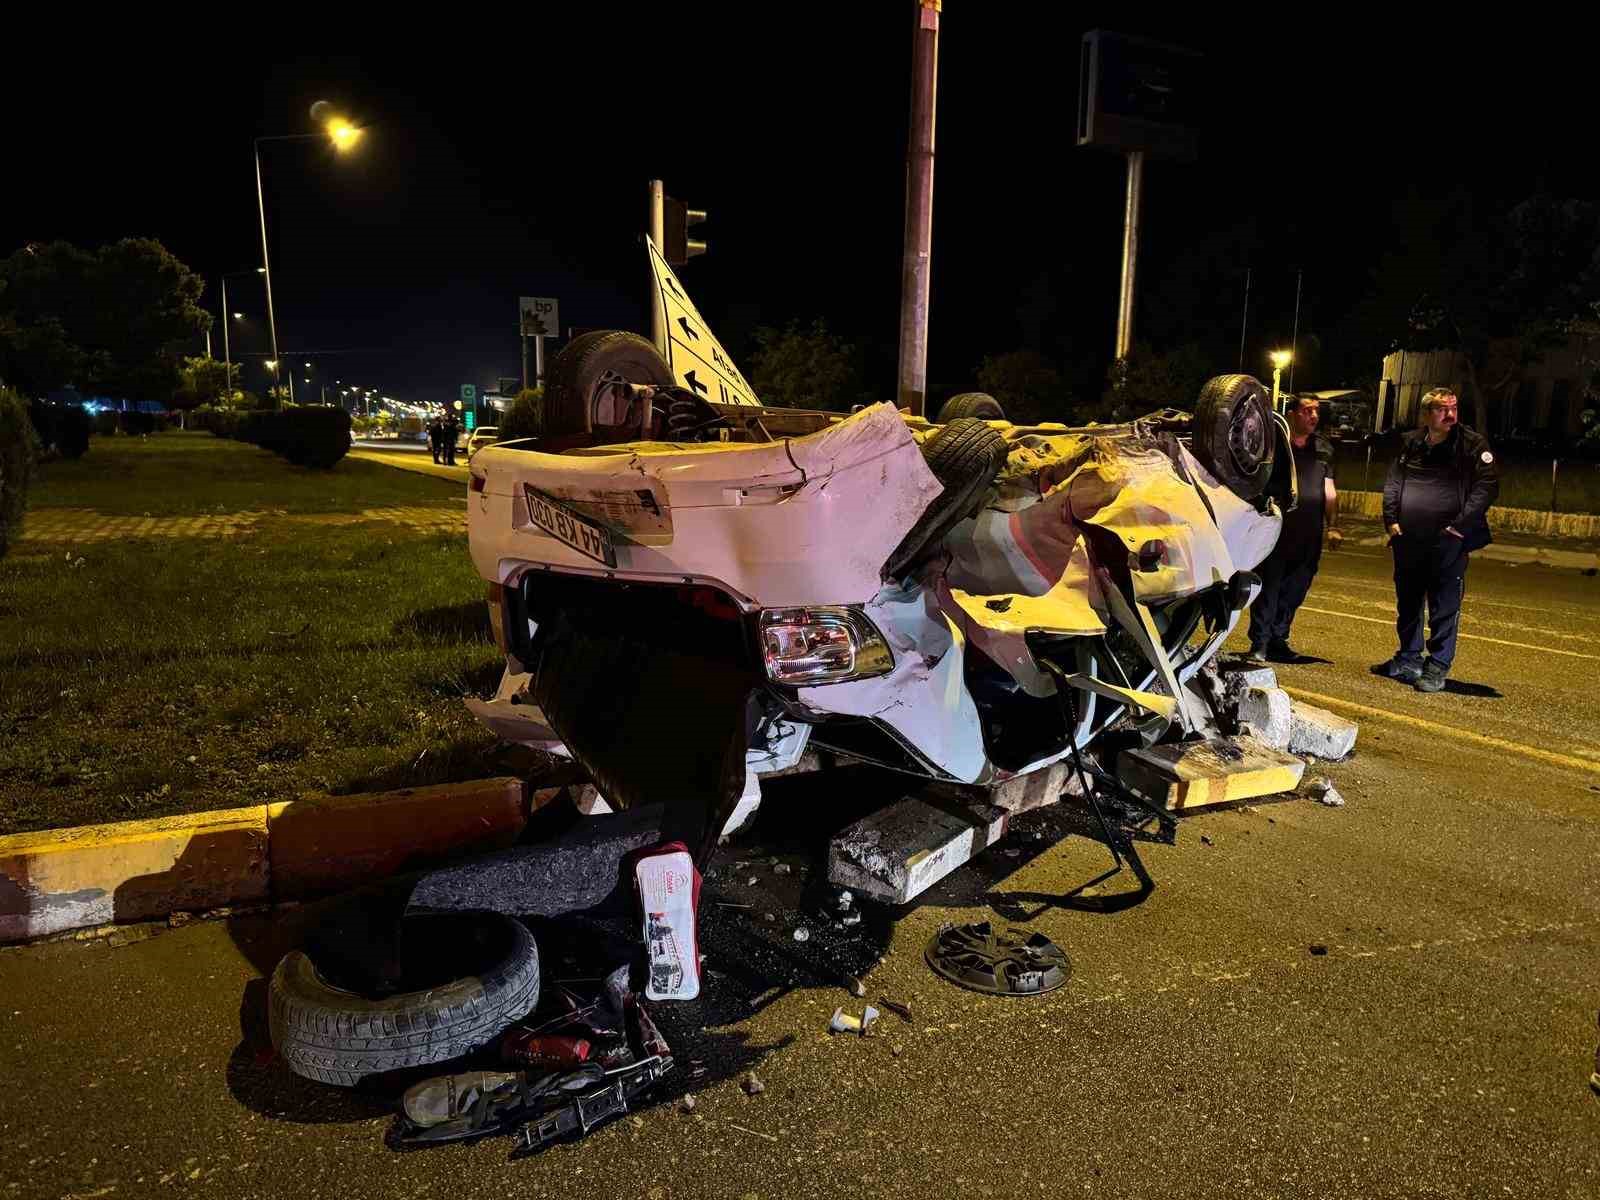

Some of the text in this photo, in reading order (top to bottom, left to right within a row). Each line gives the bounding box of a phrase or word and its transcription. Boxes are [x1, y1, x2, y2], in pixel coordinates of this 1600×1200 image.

[535, 300, 553, 315] bp
[529, 495, 554, 531] 030
[555, 512, 579, 546] KB
[580, 524, 601, 556] 44
